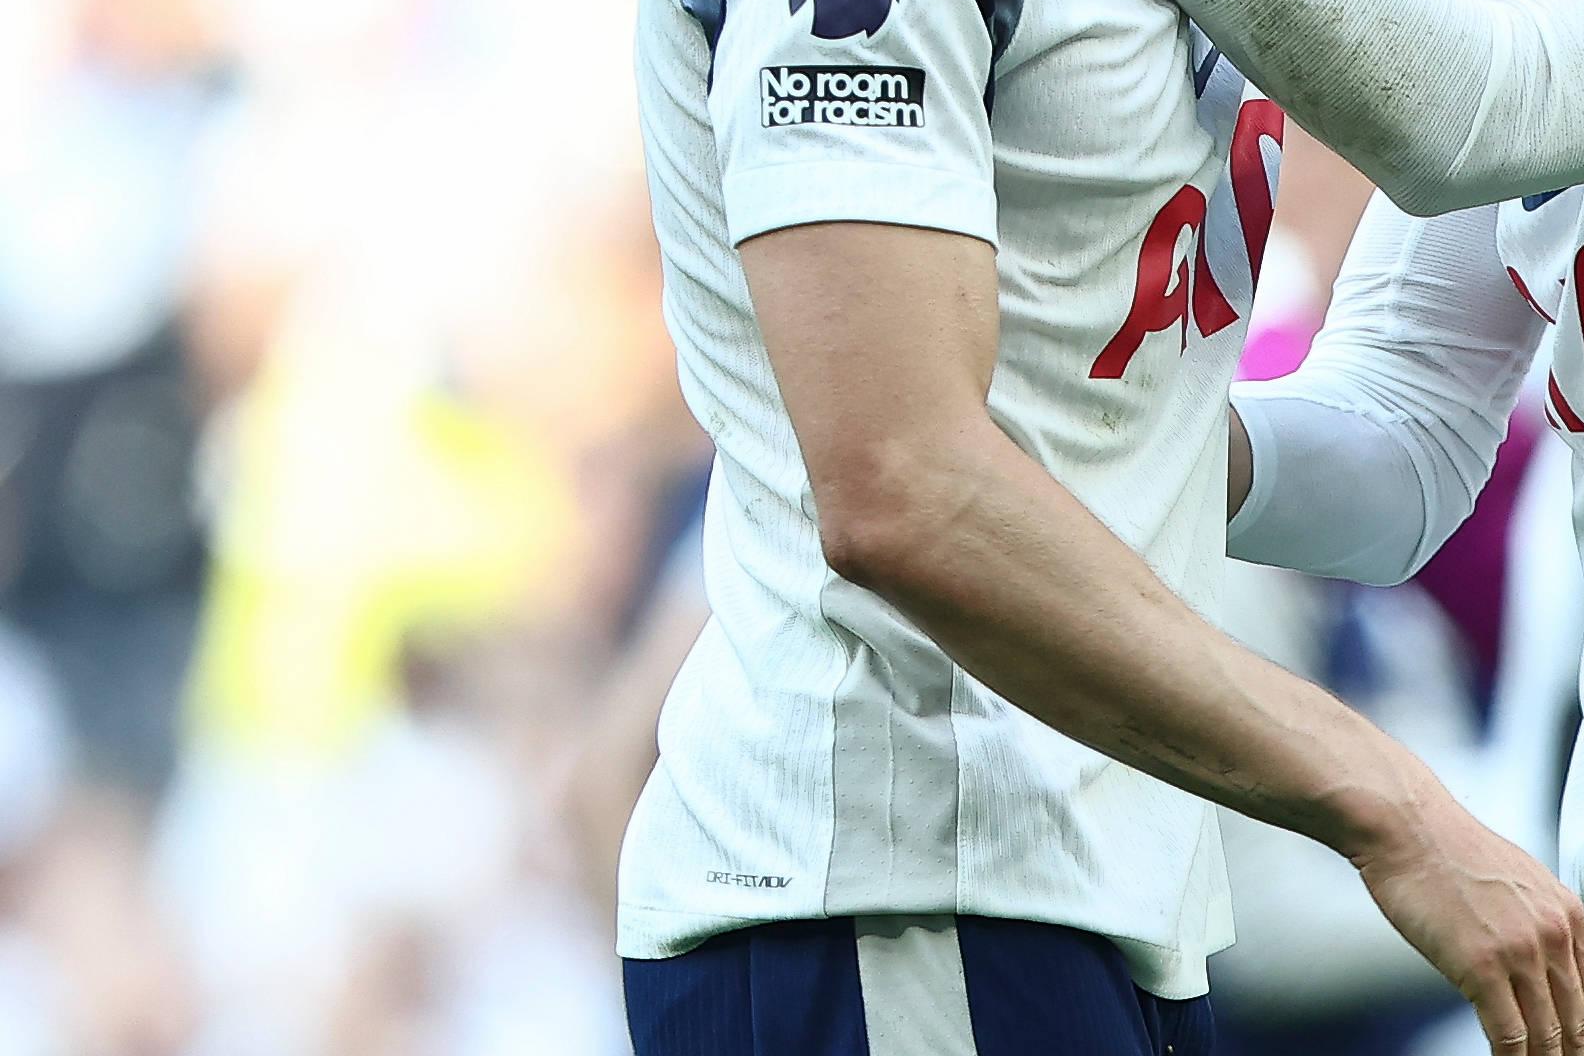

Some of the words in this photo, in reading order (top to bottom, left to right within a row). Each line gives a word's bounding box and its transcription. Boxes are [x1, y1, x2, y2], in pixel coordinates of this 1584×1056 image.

[761, 68, 811, 98] No
[816, 73, 909, 100] room
[762, 96, 810, 127] for
[813, 100, 924, 126] racism
